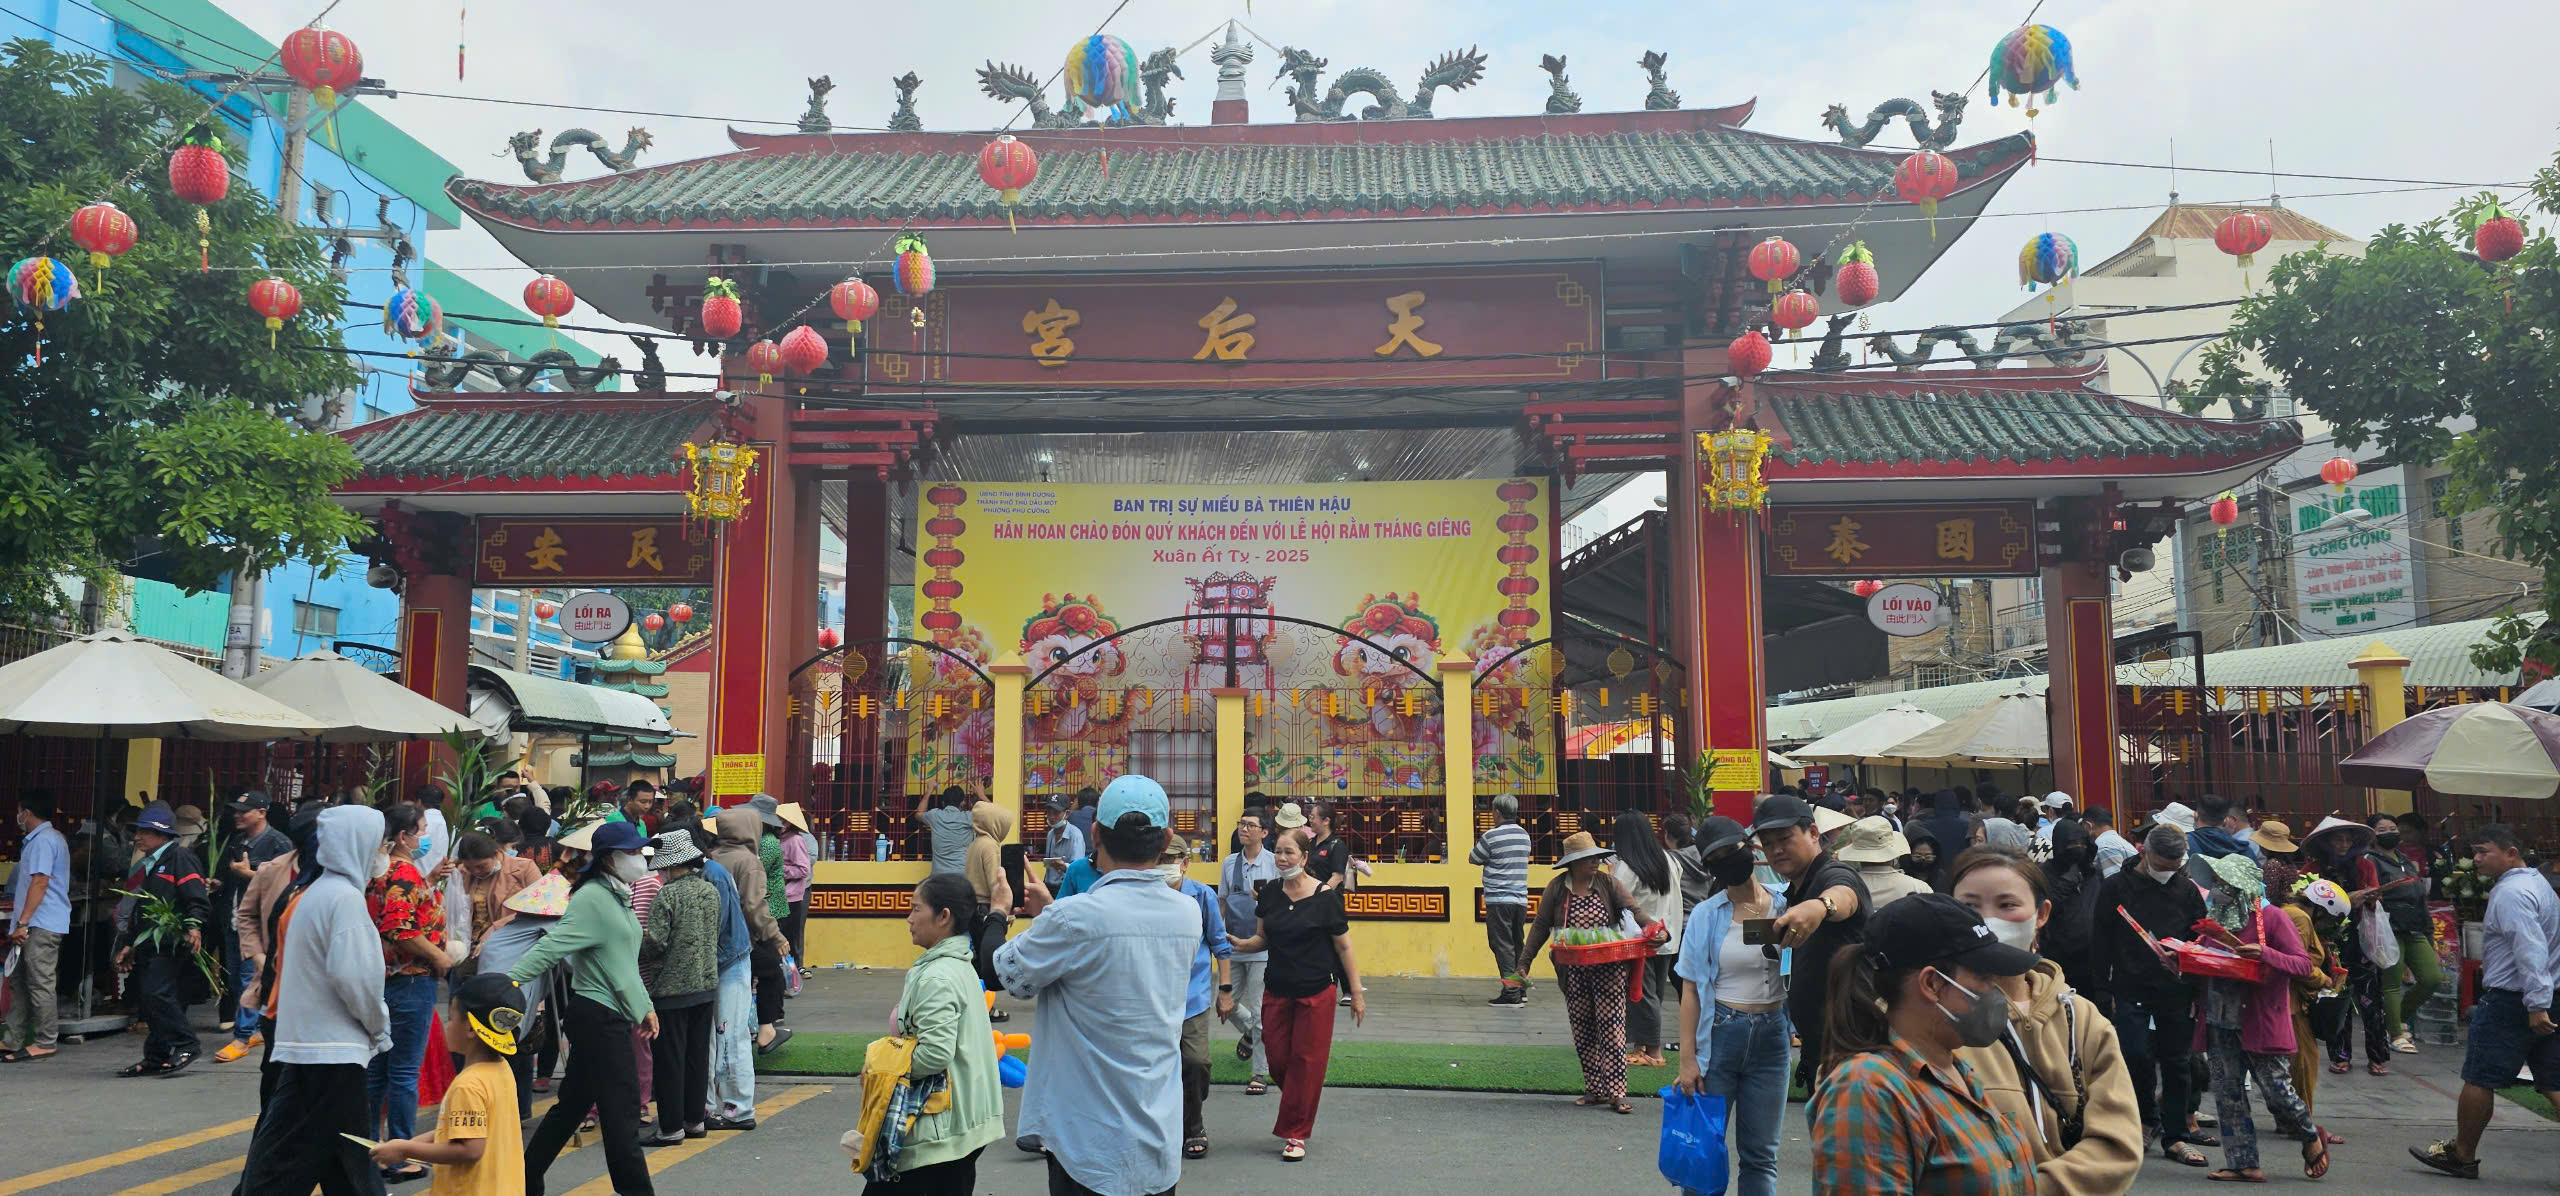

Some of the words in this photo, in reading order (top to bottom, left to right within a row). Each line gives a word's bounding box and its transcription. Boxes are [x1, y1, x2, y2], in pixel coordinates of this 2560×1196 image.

[1113, 499, 1145, 512] BAN
[1149, 499, 1173, 516] TRỊ
[1178, 497, 1199, 516] SỰ
[1202, 494, 1239, 513] MIẾU
[1244, 496, 1264, 512] BÀ
[1269, 495, 1315, 512] THIÊN
[1319, 495, 1351, 515] HẬU
[2359, 484, 2401, 519] SINH
[993, 519, 1024, 539] HÂN
[1027, 523, 1066, 540] HOAN
[1069, 519, 1109, 540] CHÀO
[1112, 520, 1141, 540] ĐÓN
[1145, 521, 1174, 541] QUÝ
[1177, 520, 1226, 541] KHÁCH
[1230, 518, 1258, 541] ĐẾN
[1263, 520, 1286, 541] VỚI
[1290, 516, 1306, 541] LỄ
[1311, 520, 1335, 544] HỘI
[1340, 516, 1370, 539] RẰM
[1374, 518, 1422, 538] THÁNG
[1426, 517, 1471, 537] GIÊNG
[1152, 549, 1196, 563] Xuân
[1202, 543, 1223, 563] Ất
[1265, 549, 1310, 563] 2025
[575, 603, 593, 619] LỐI
[596, 607, 612, 619] RA
[1882, 595, 1903, 611] LỐI
[1906, 597, 1932, 611] VÀO
[574, 620, 612, 631] 由此門出
[1886, 613, 1928, 624] 由此門入
